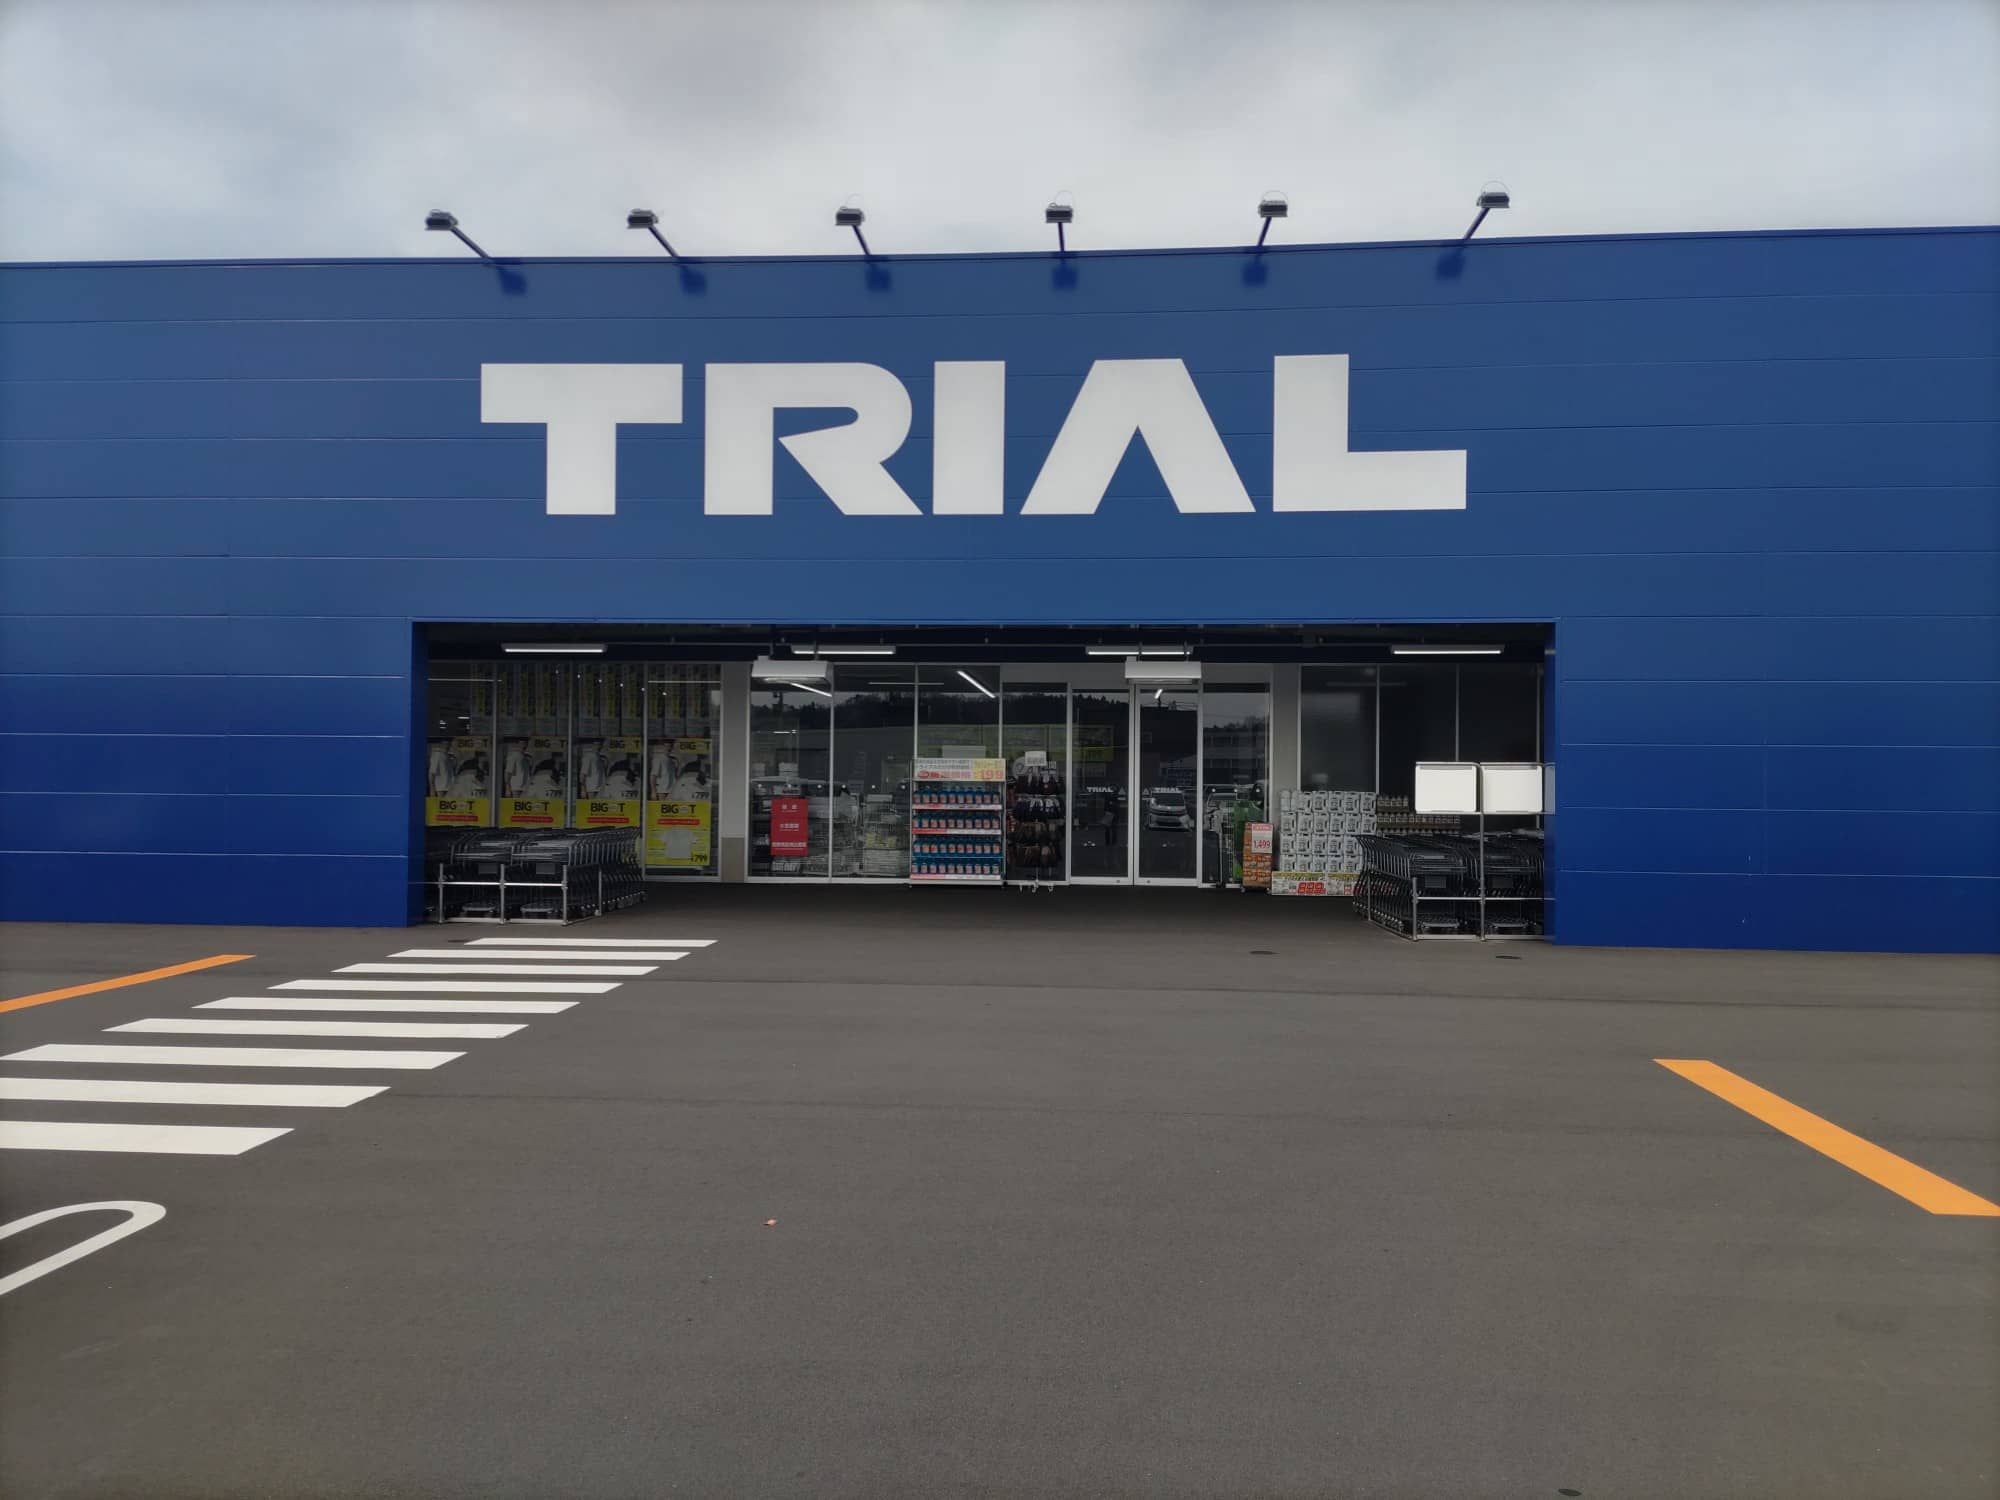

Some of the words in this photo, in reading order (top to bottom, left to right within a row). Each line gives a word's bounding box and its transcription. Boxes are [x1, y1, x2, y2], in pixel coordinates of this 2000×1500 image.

[480, 353, 1467, 516] TRIAL
[439, 801, 457, 811] BIG
[514, 802, 532, 812] BIG
[590, 802, 609, 813] BIG
[661, 804, 679, 814] BIG
